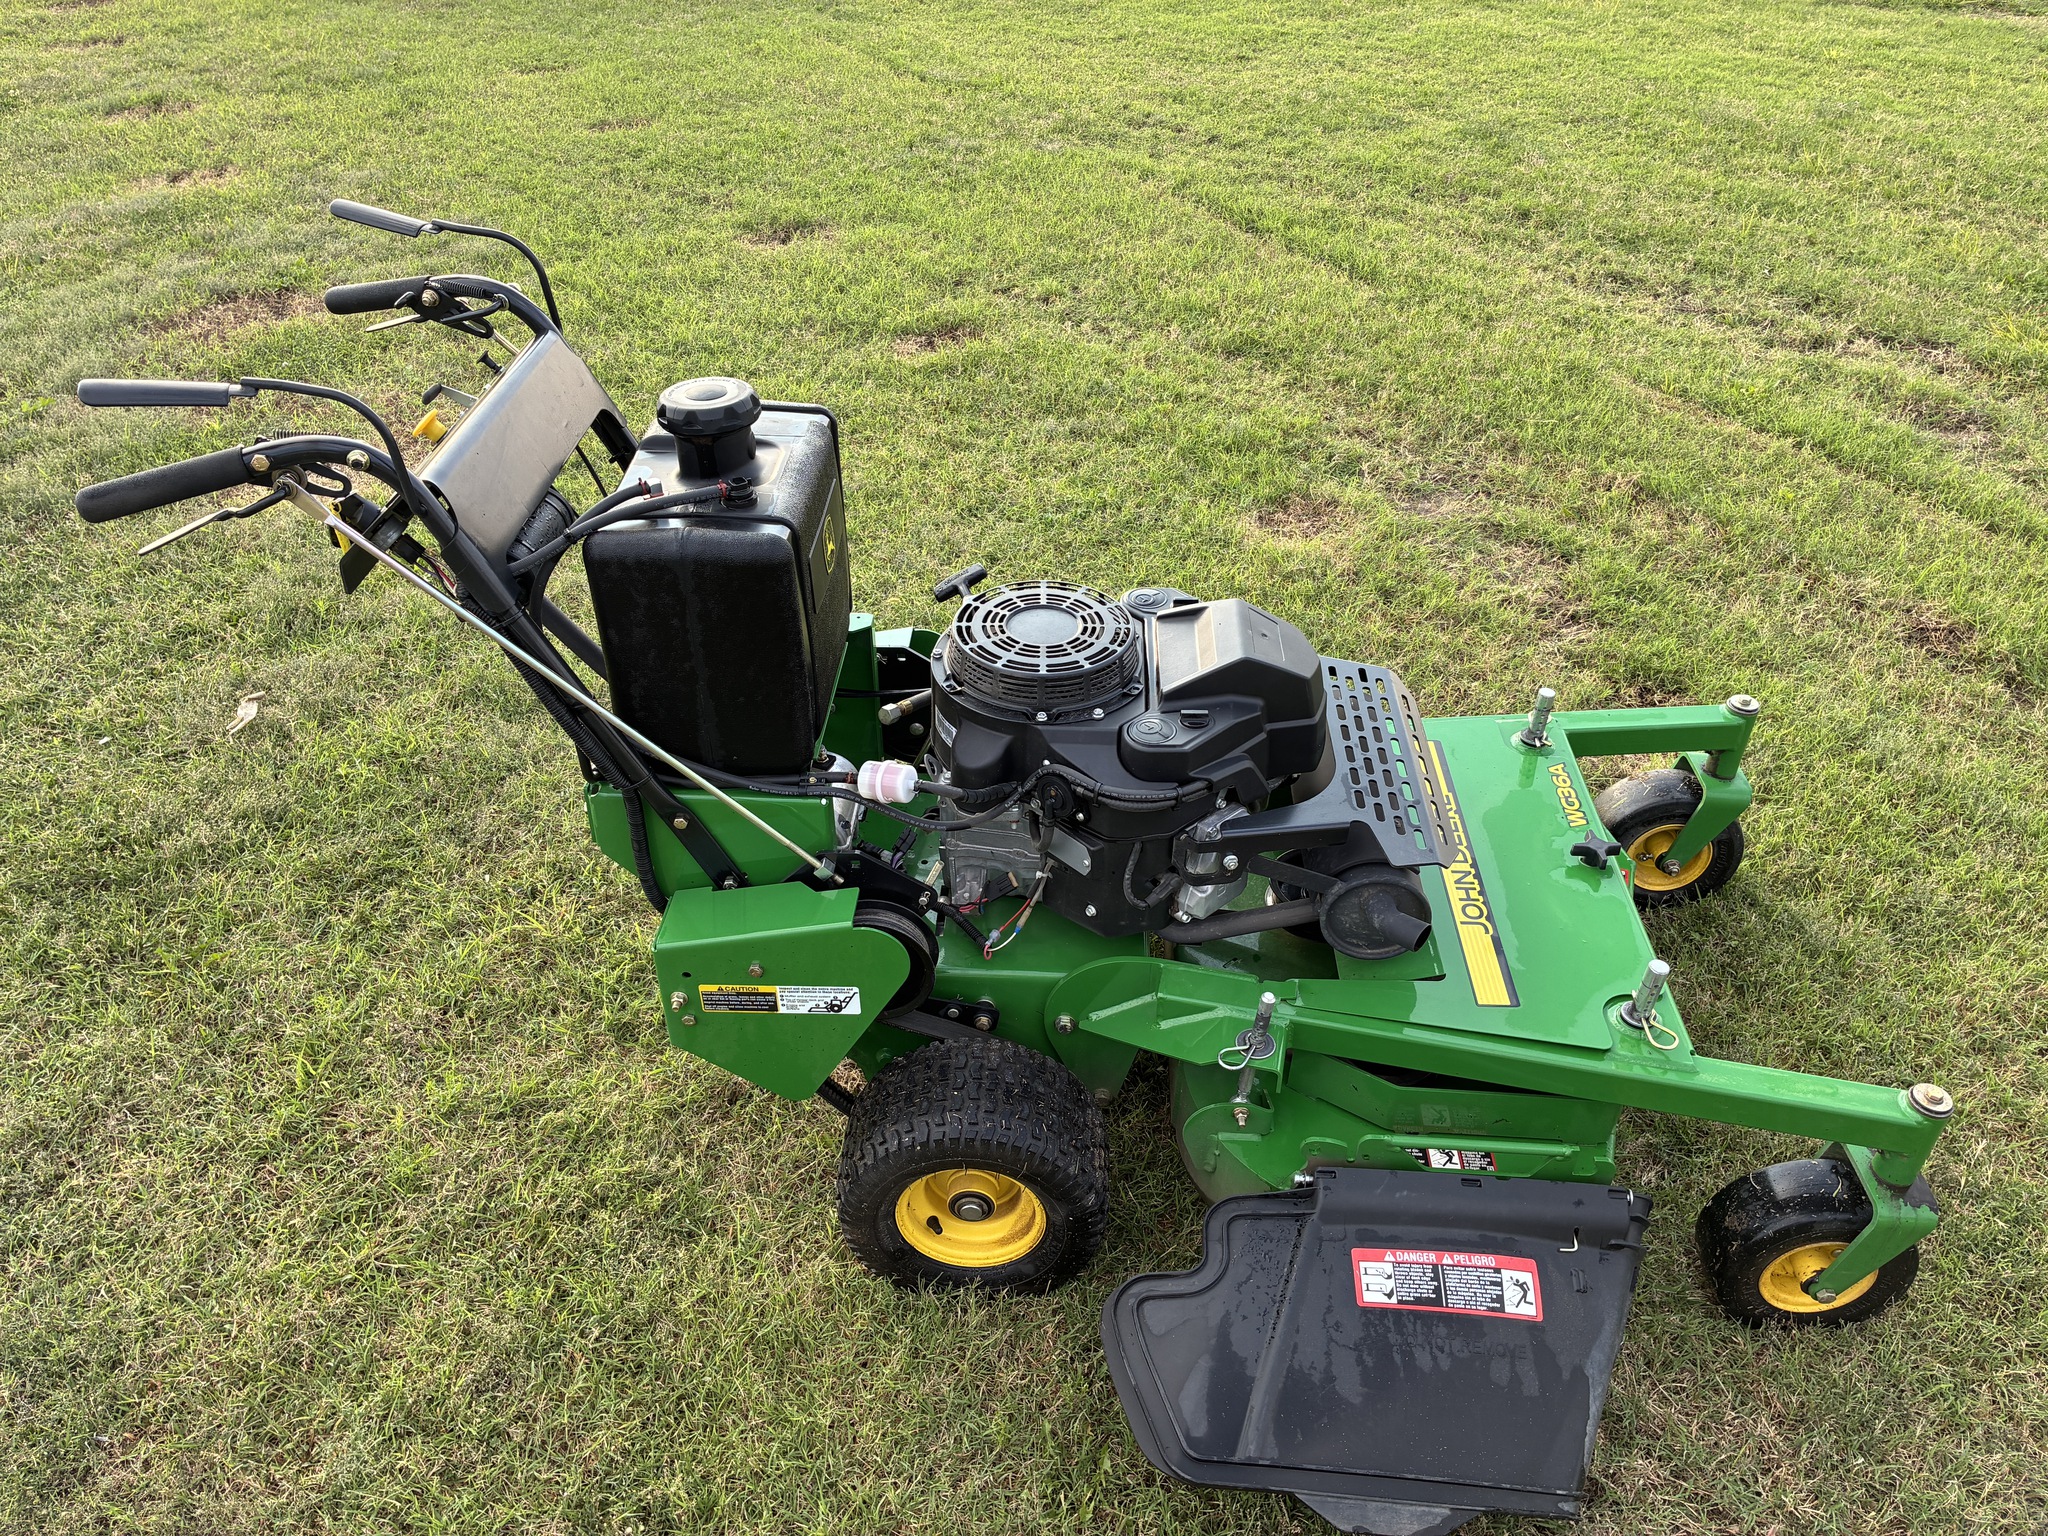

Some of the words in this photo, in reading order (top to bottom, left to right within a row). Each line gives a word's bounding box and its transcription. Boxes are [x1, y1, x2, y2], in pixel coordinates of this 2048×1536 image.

[1547, 762, 1589, 828] WG36A
[1451, 869, 1490, 935] JOHN
[1395, 1251, 1436, 1262] DANGER
[1453, 1254, 1495, 1266] PELIGRO
[1461, 1338, 1527, 1360] REMOVE
